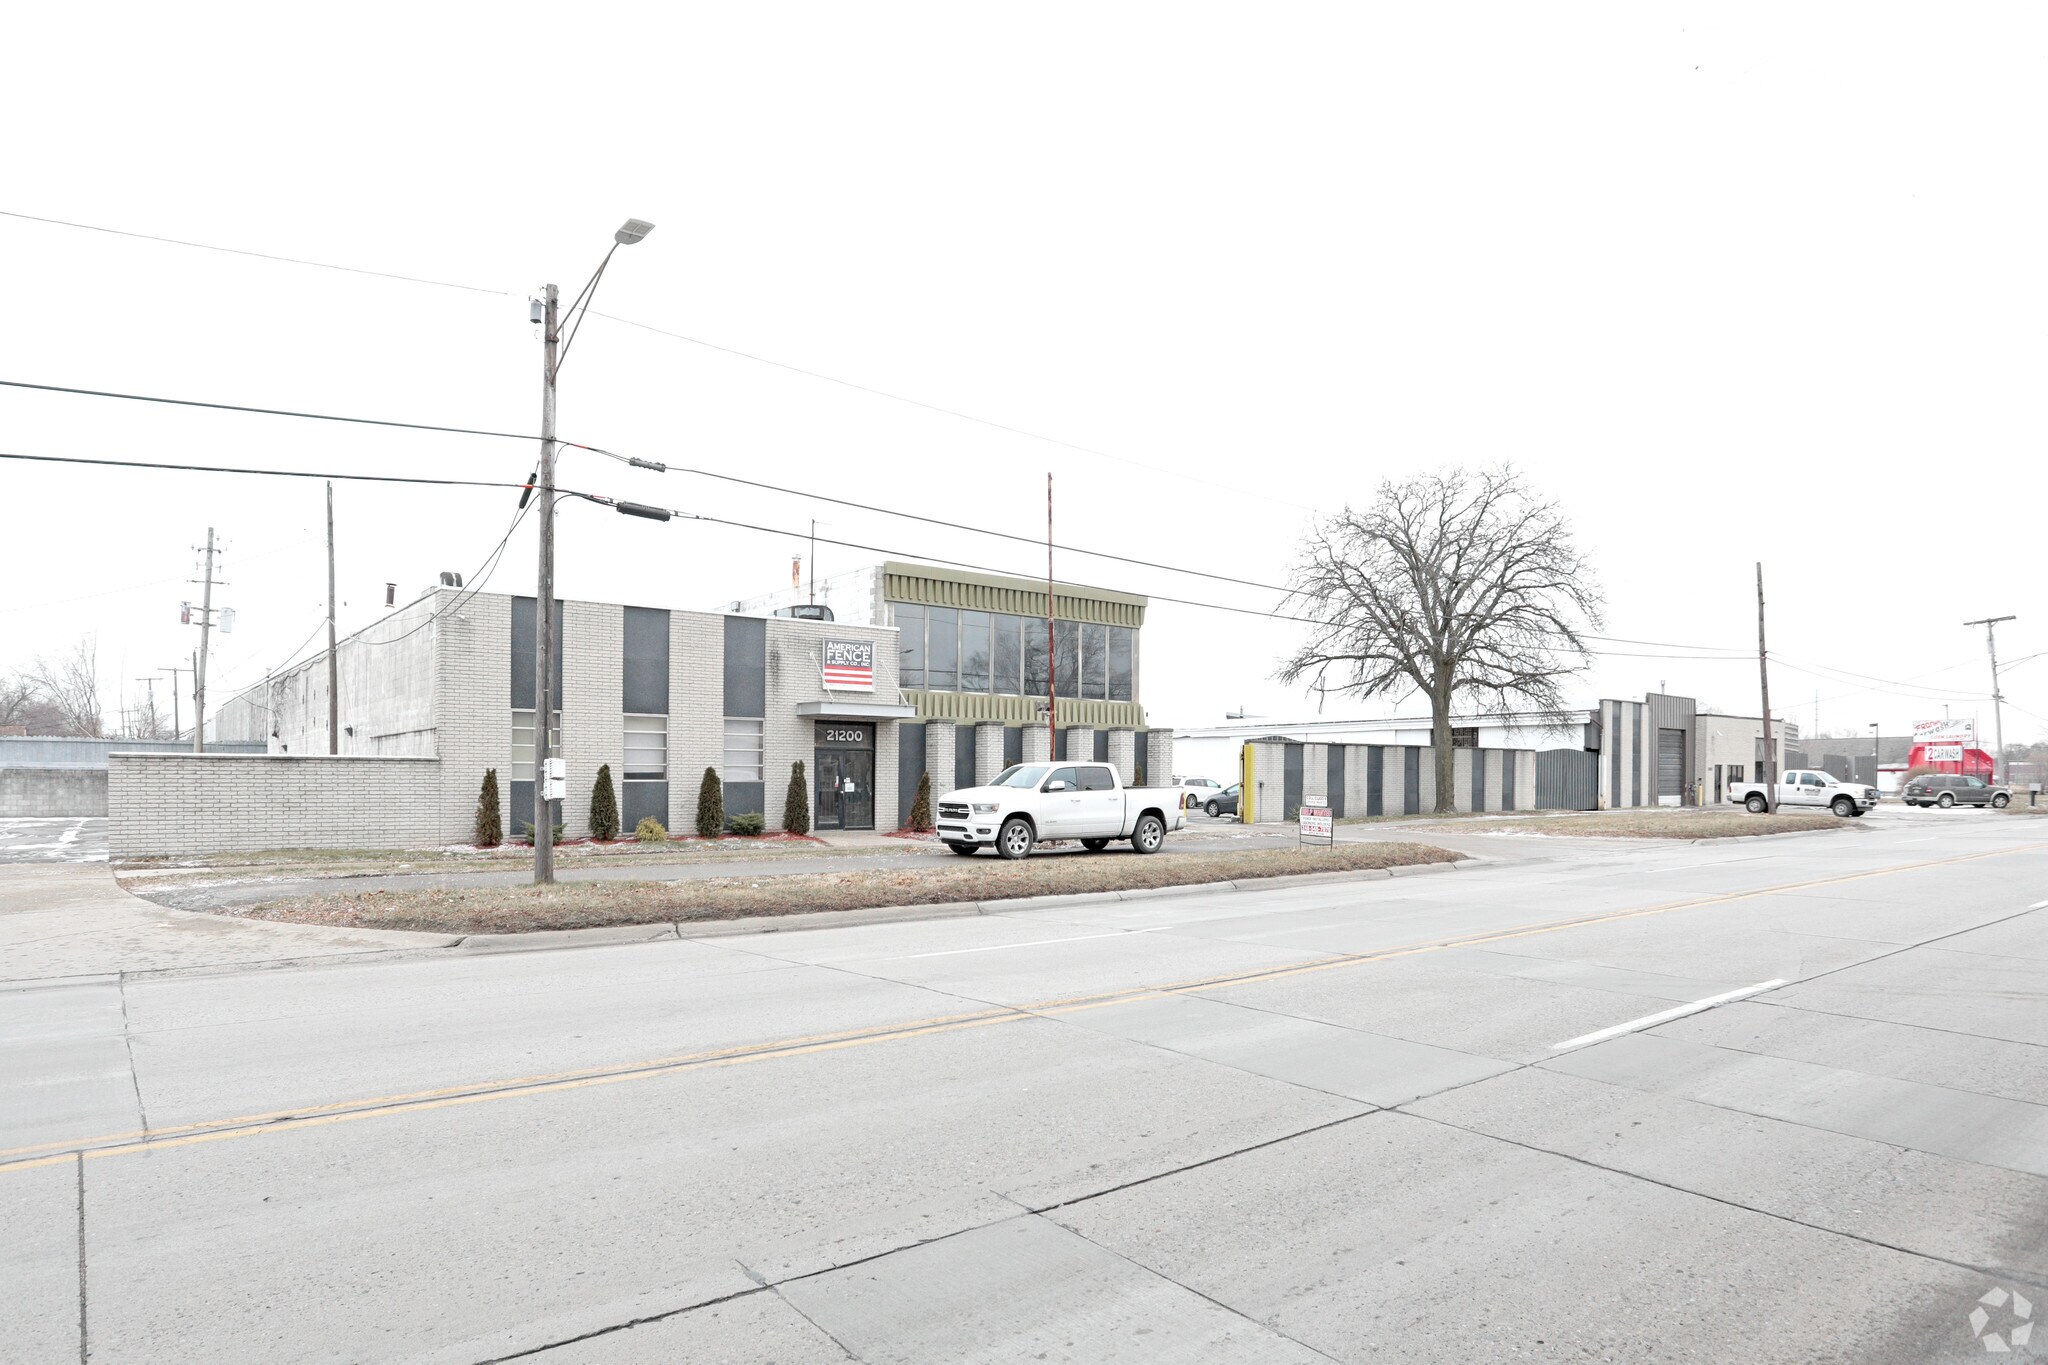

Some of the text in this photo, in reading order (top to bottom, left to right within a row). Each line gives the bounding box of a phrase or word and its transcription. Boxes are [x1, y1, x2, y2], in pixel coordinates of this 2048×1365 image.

[827, 641, 871, 652] AMERICAN
[827, 650, 871, 662] FENCE
[826, 730, 863, 741] 21200
